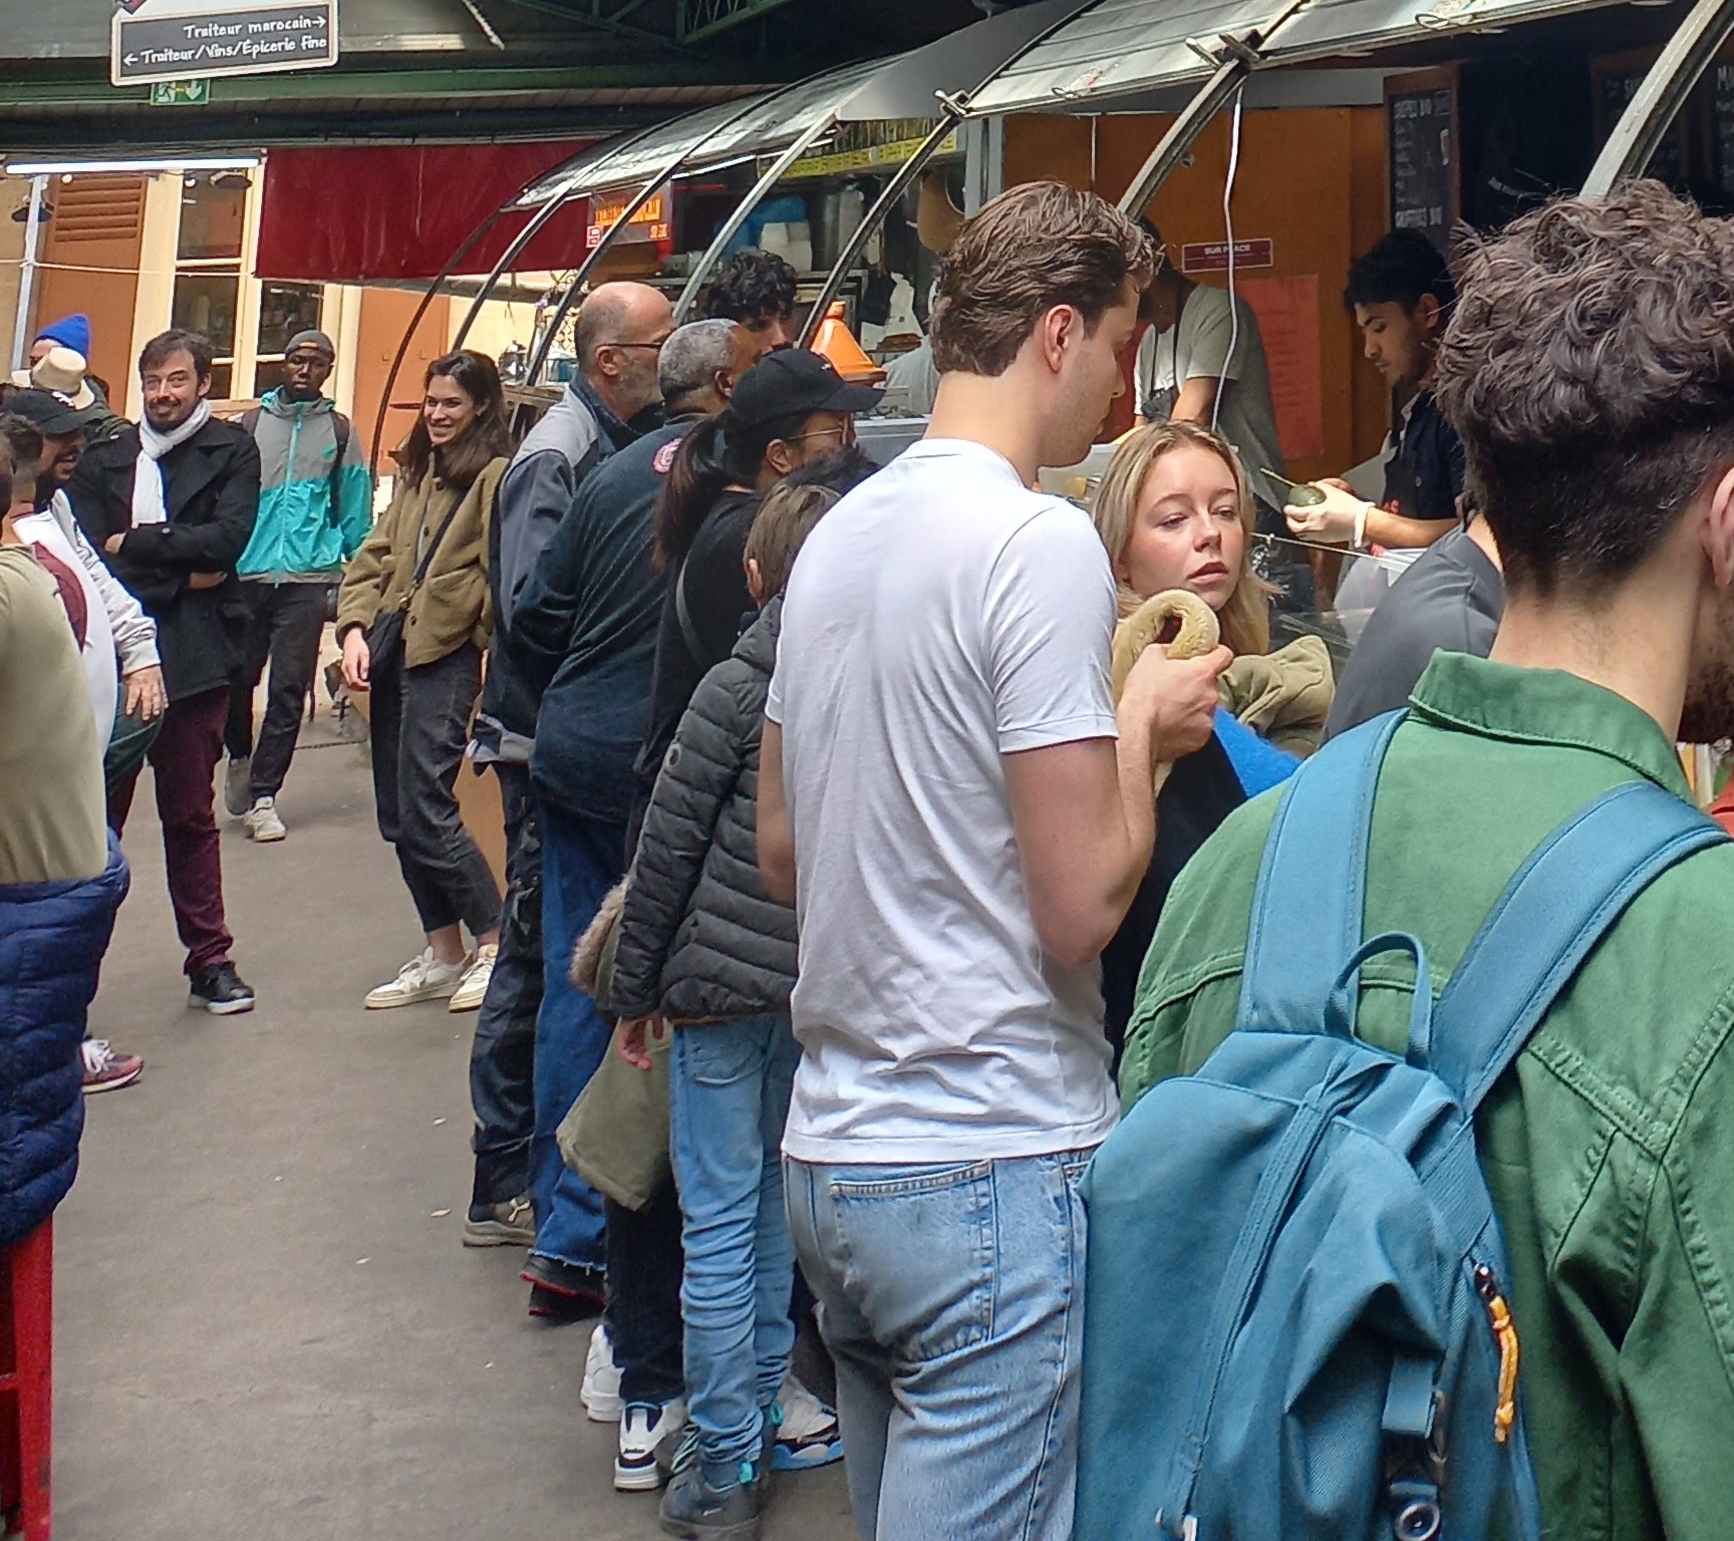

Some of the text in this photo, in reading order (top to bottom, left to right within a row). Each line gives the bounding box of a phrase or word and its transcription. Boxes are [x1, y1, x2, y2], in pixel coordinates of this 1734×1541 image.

[183, 14, 313, 40] Traiteur marocain
[301, 35, 327, 51] fine
[1222, 244, 1251, 254] PACE
